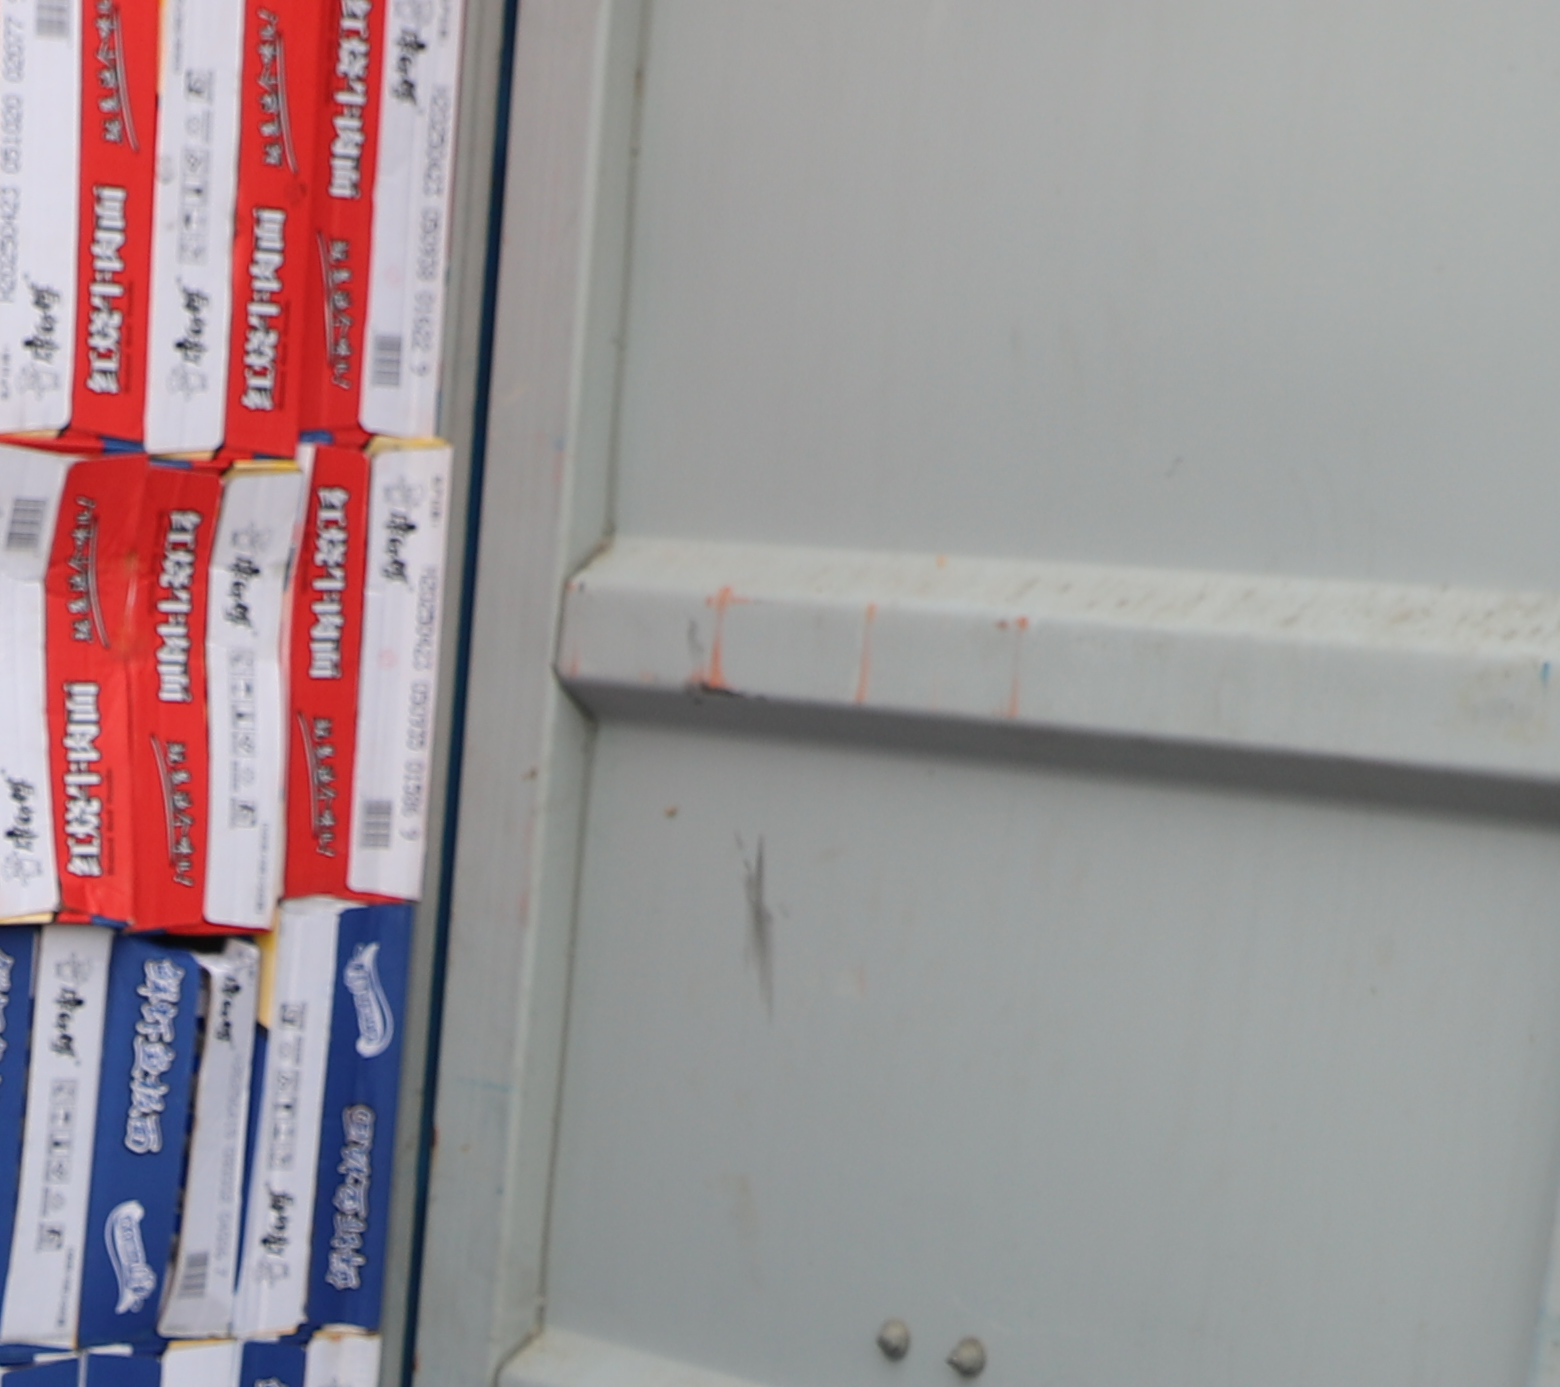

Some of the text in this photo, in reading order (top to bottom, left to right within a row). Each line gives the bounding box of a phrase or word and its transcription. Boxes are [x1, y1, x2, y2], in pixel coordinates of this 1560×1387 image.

[87, 186, 127, 393] 红烧牛肉面
[242, 208, 286, 410] 红烧牛肉面
[157, 510, 202, 701] 红烧牛肉面
[309, 487, 349, 678] 红烧牛肉面
[63, 682, 102, 876] 红烧牛肉面
[125, 960, 184, 1153] 鲜虾鱼板面
